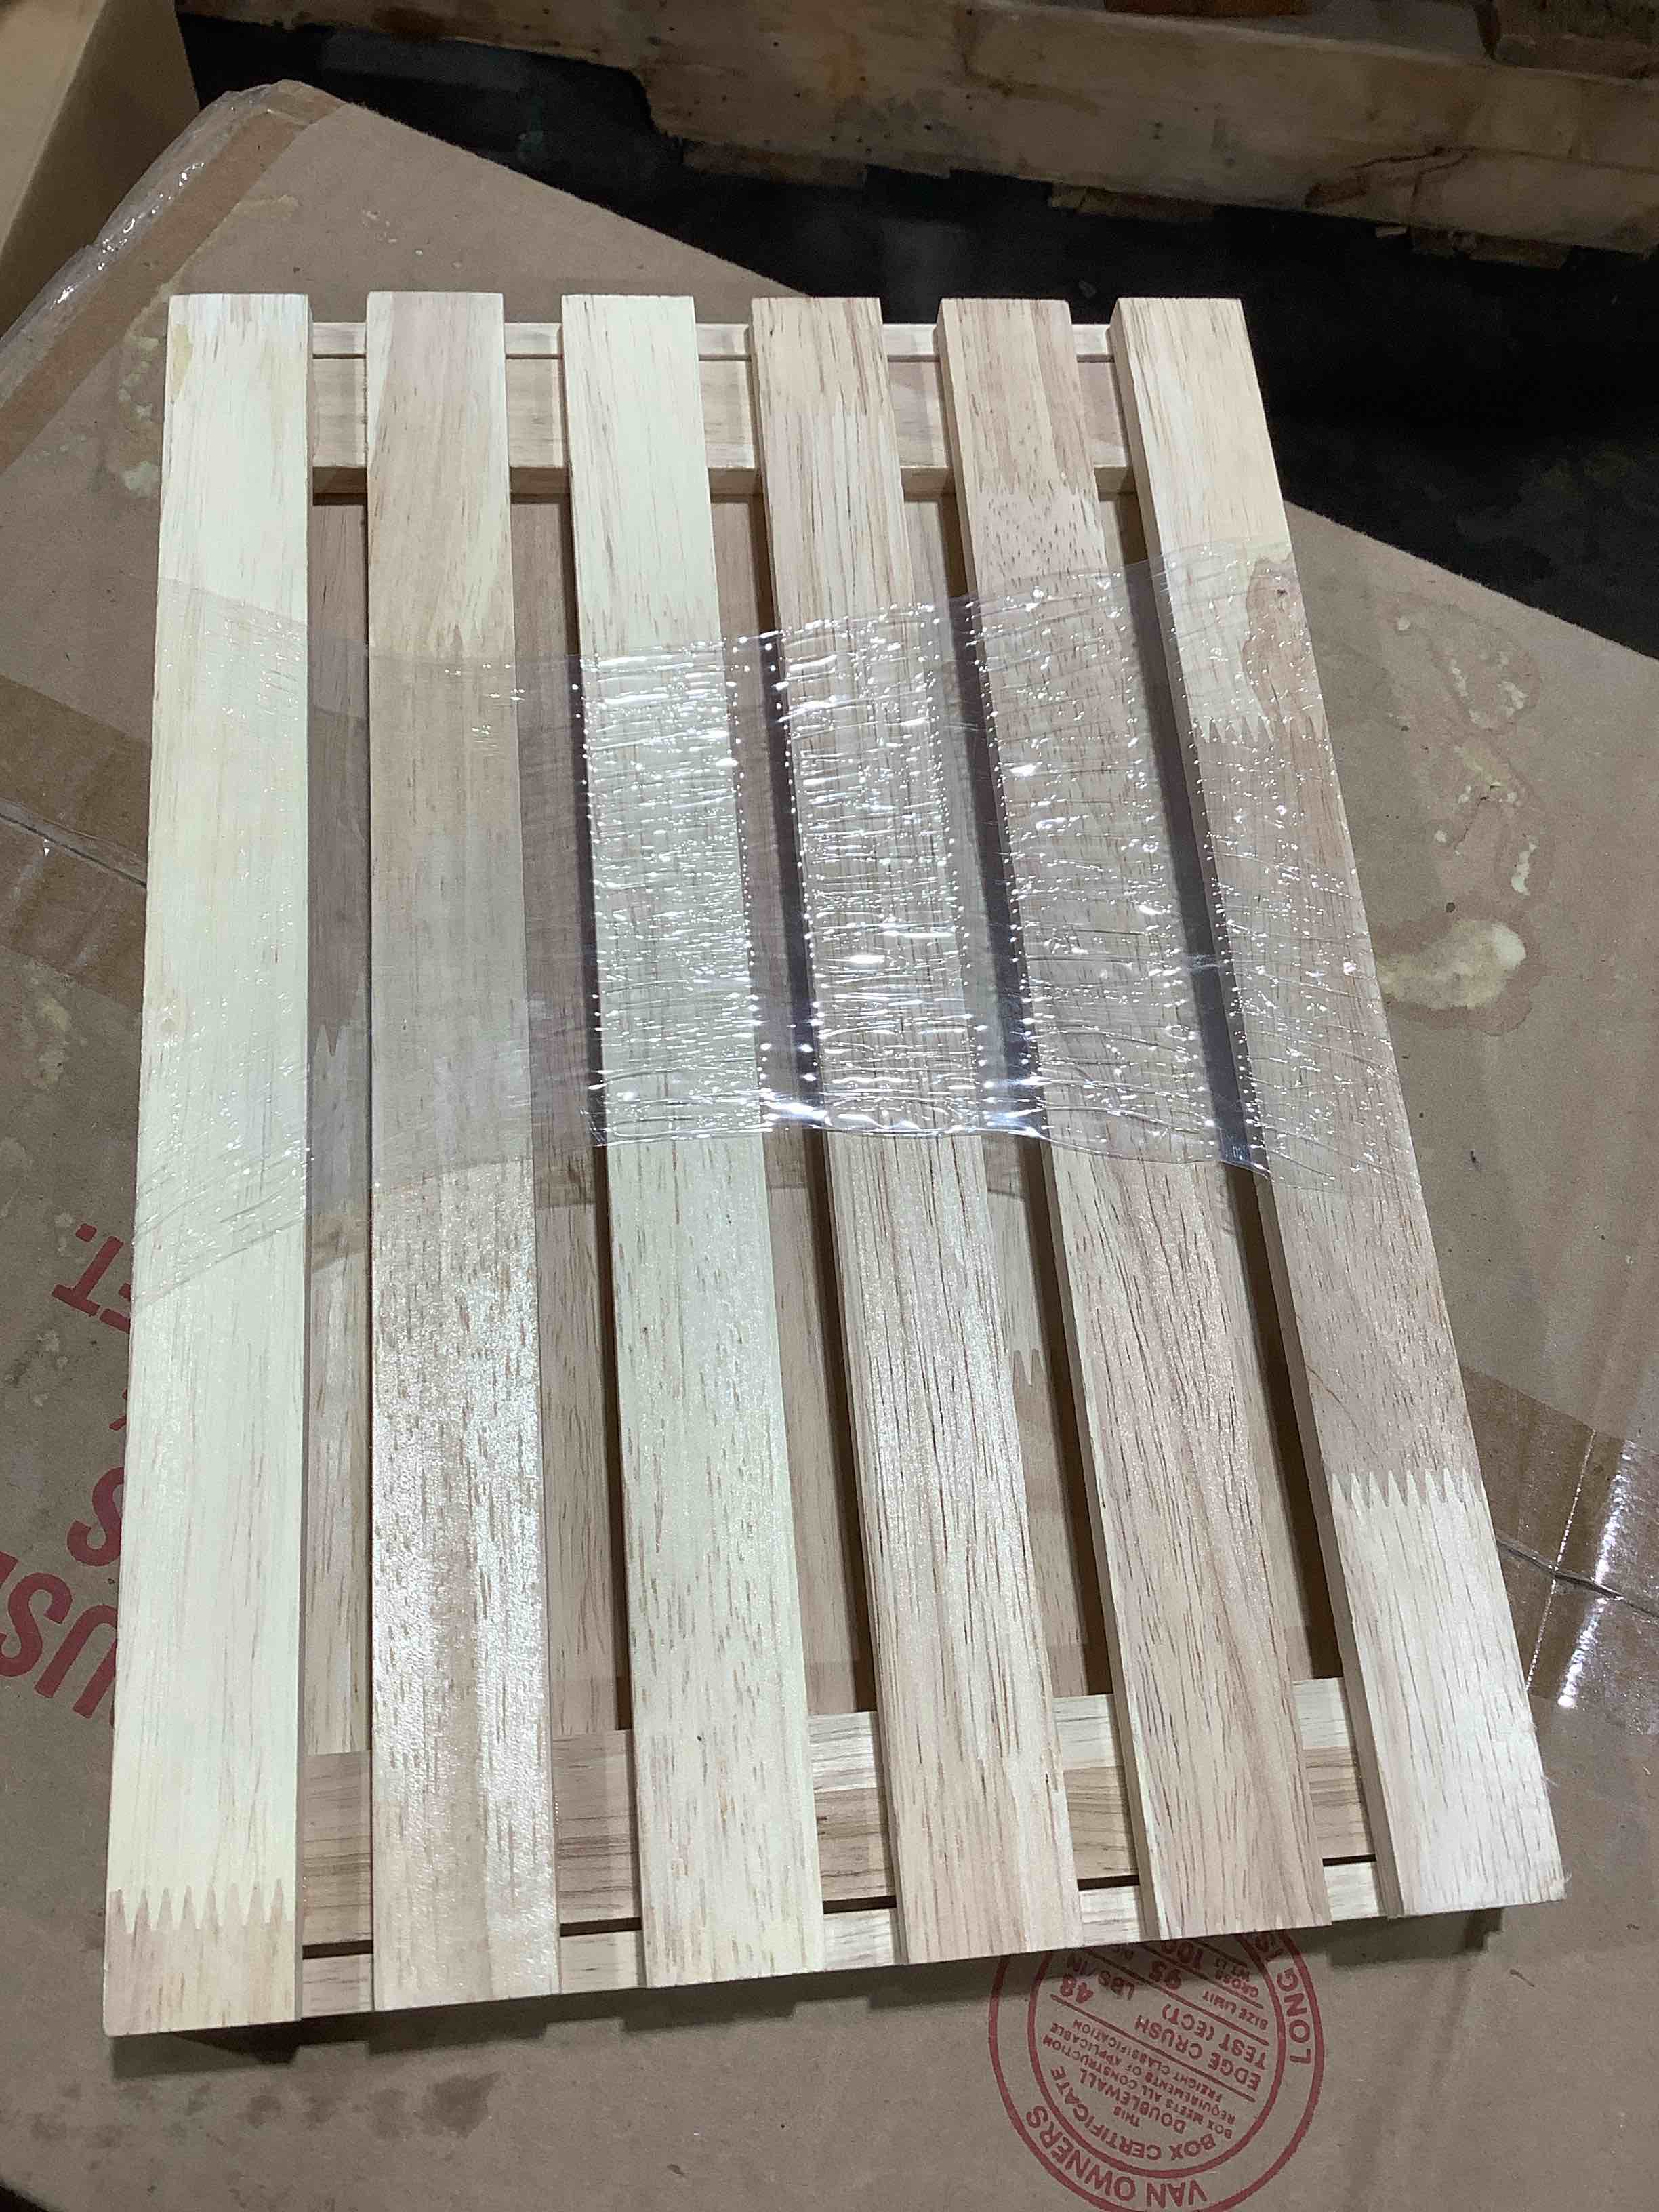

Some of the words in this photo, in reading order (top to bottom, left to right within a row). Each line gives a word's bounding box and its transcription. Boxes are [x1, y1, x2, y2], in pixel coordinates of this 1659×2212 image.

[1202, 1988, 1237, 2014] LIMIT
[1214, 1969, 1260, 1999] GROSS
[1159, 2002, 1217, 2042] (ECT)
[1237, 2007, 1269, 2030] SIZE
[1277, 1968, 1311, 2065] LONG
[1048, 2022, 1122, 2066] APPLICABLE
[1071, 2018, 1171, 2075] CLASSIFICATION
[1133, 2014, 1205, 2061] CRUSH
[1218, 2032, 1270, 2070] TEST
[1042, 2034, 1138, 2090] CONSTRUCTION
[1125, 2062, 1143, 2076] OF
[1206, 2051, 1262, 2090] EDGE
[1078, 2069, 1186, 2133] DOUBLEWALL
[1139, 2085, 1161, 2102] ALL
[1144, 2071, 1236, 2124] REQUIREMENTS
[1173, 2071, 1223, 2102] FREIGHT
[1049, 2065, 1162, 2161] CERTIFICATE
[1112, 2106, 1141, 2127] THIS
[1164, 2098, 1204, 2124] MEETS
[1206, 2120, 1233, 2139] BOX
[1025, 2105, 1136, 2203] OWNERS
[1168, 2133, 1216, 2162] BOX
[1146, 2179, 1208, 2209] VAN
